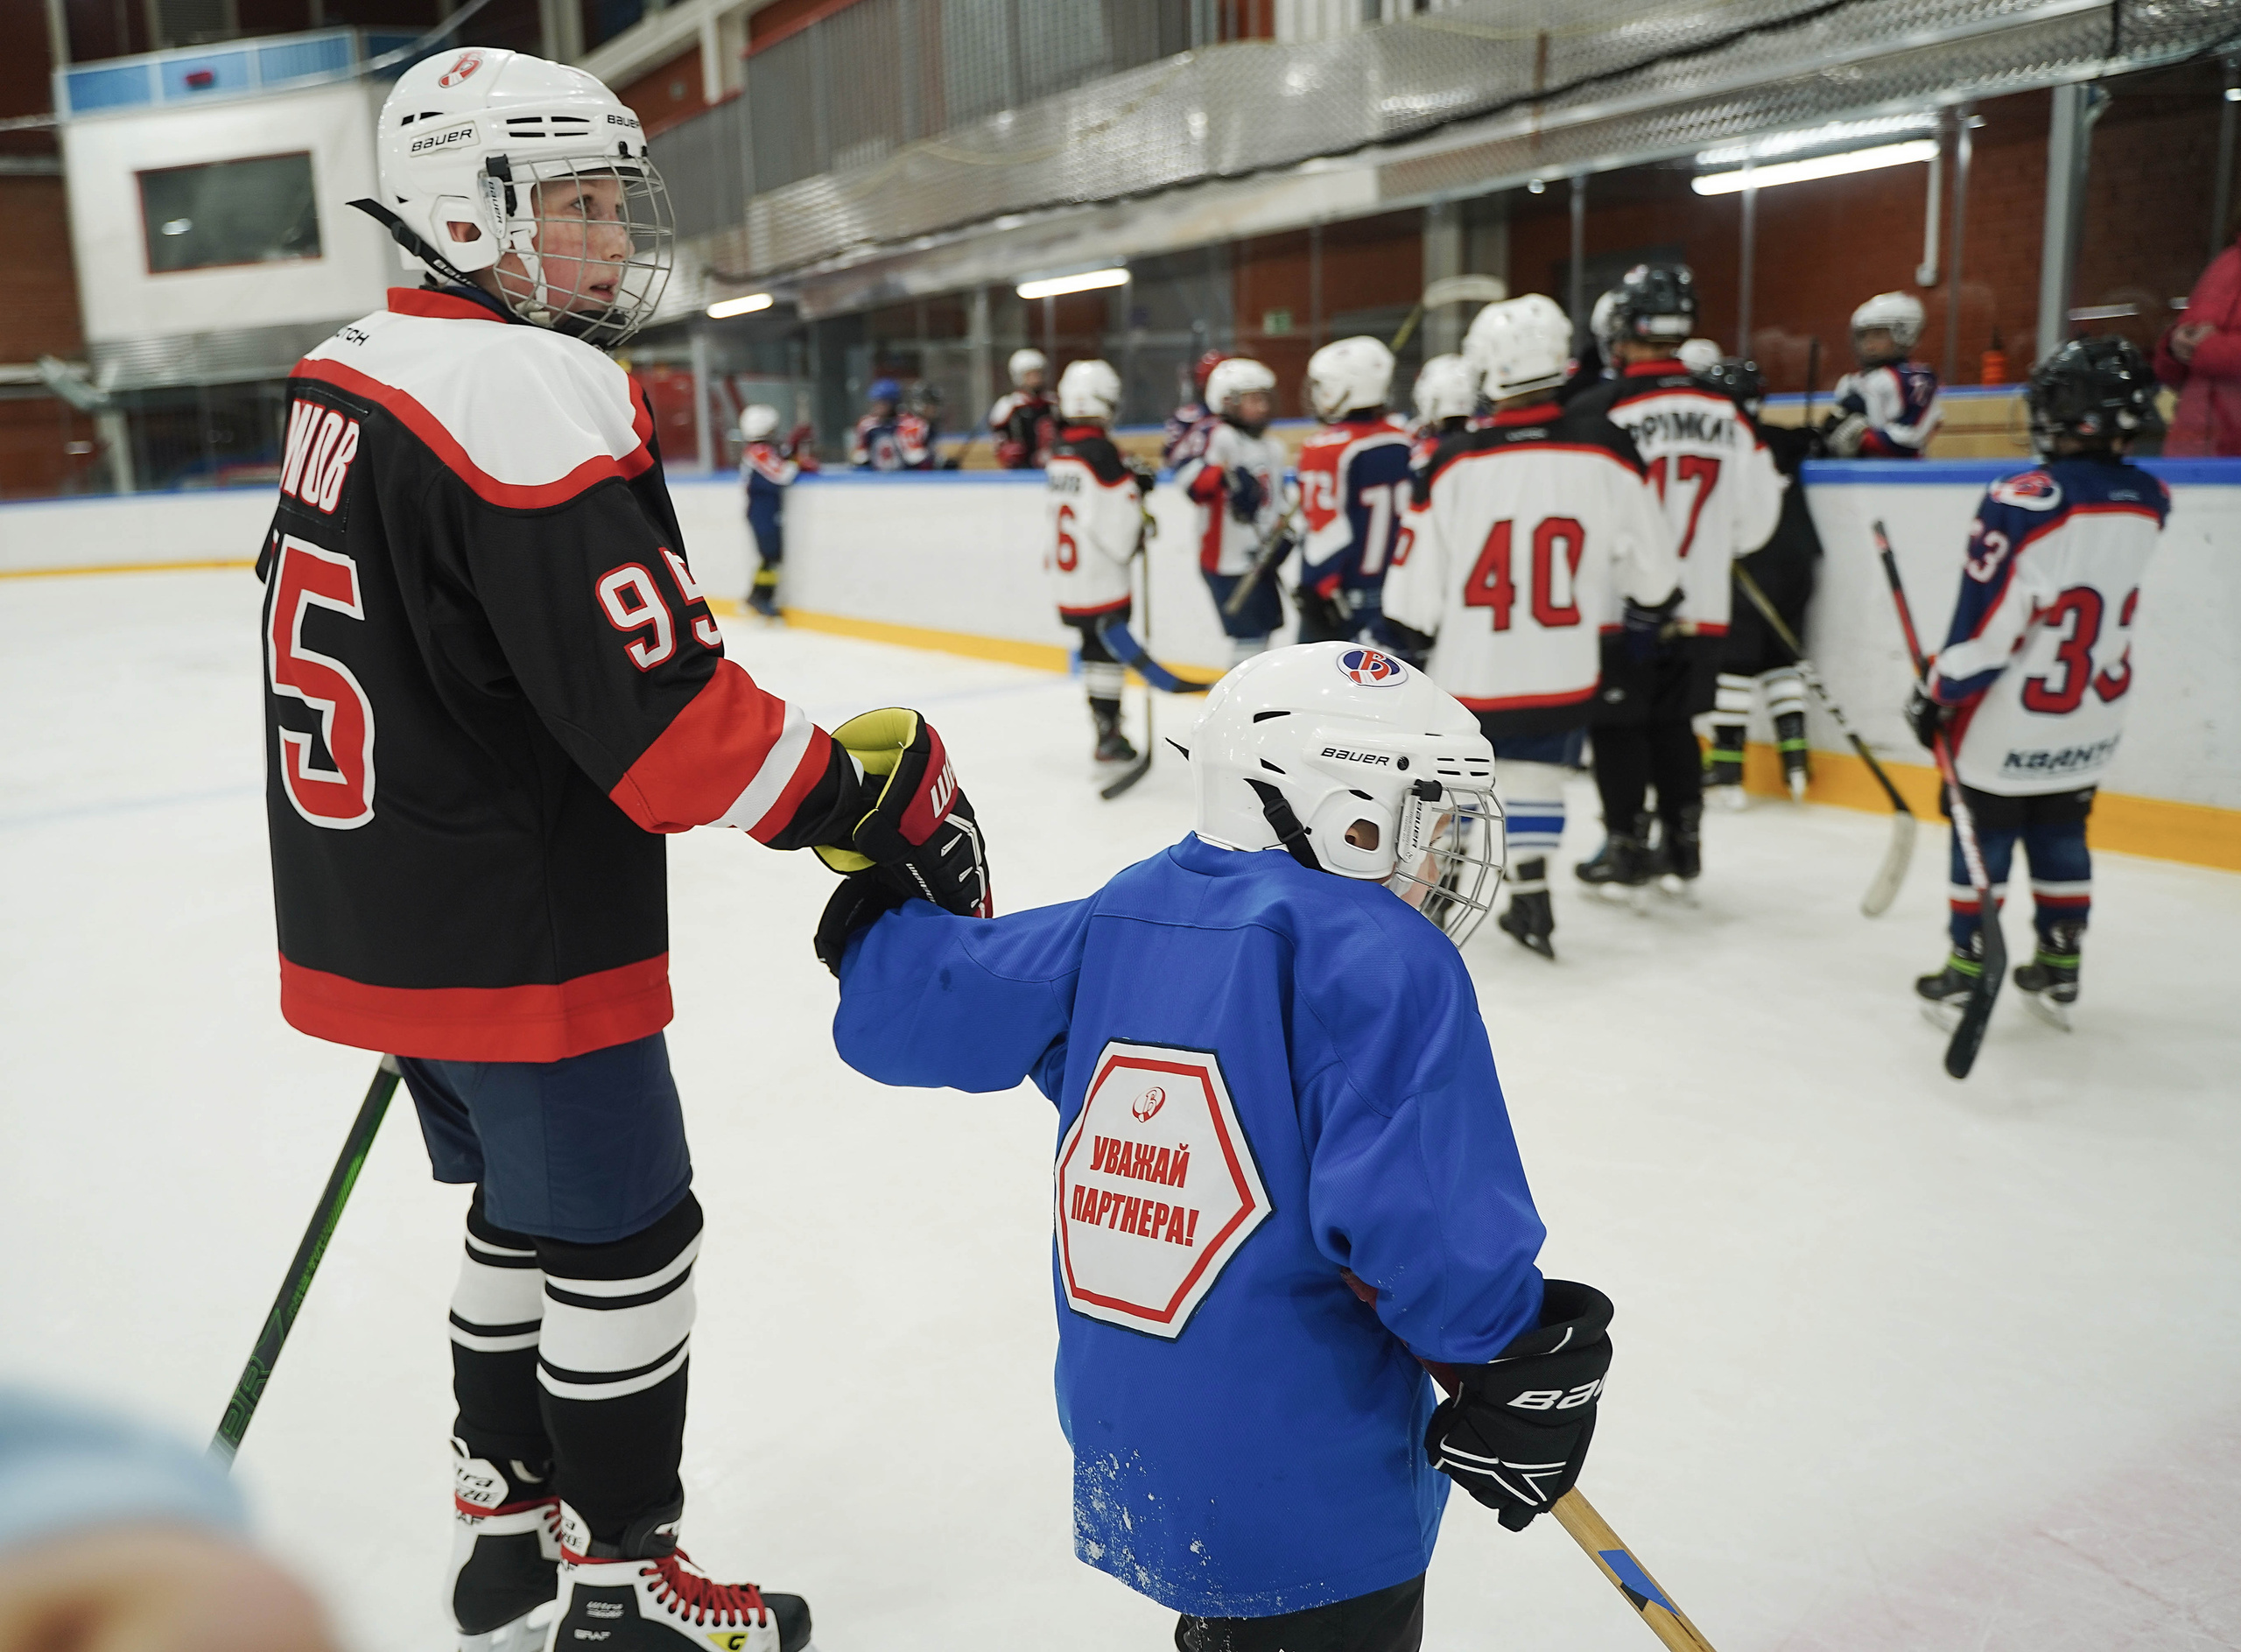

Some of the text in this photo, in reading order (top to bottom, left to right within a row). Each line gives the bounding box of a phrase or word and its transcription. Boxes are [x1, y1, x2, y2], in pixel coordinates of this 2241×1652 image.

[411, 128, 473, 152] BAUER
[1045, 504, 1078, 572] 6
[1465, 517, 1585, 632] 40
[595, 546, 723, 672] 95
[265, 529, 376, 831] 5
[1320, 747, 1390, 767] BAUER
[1090, 1135, 1191, 1189] УВАЖАЙ
[1071, 1185, 1199, 1248] ПАРТНЕРА!
[573, 1628, 612, 1641] GRAF
